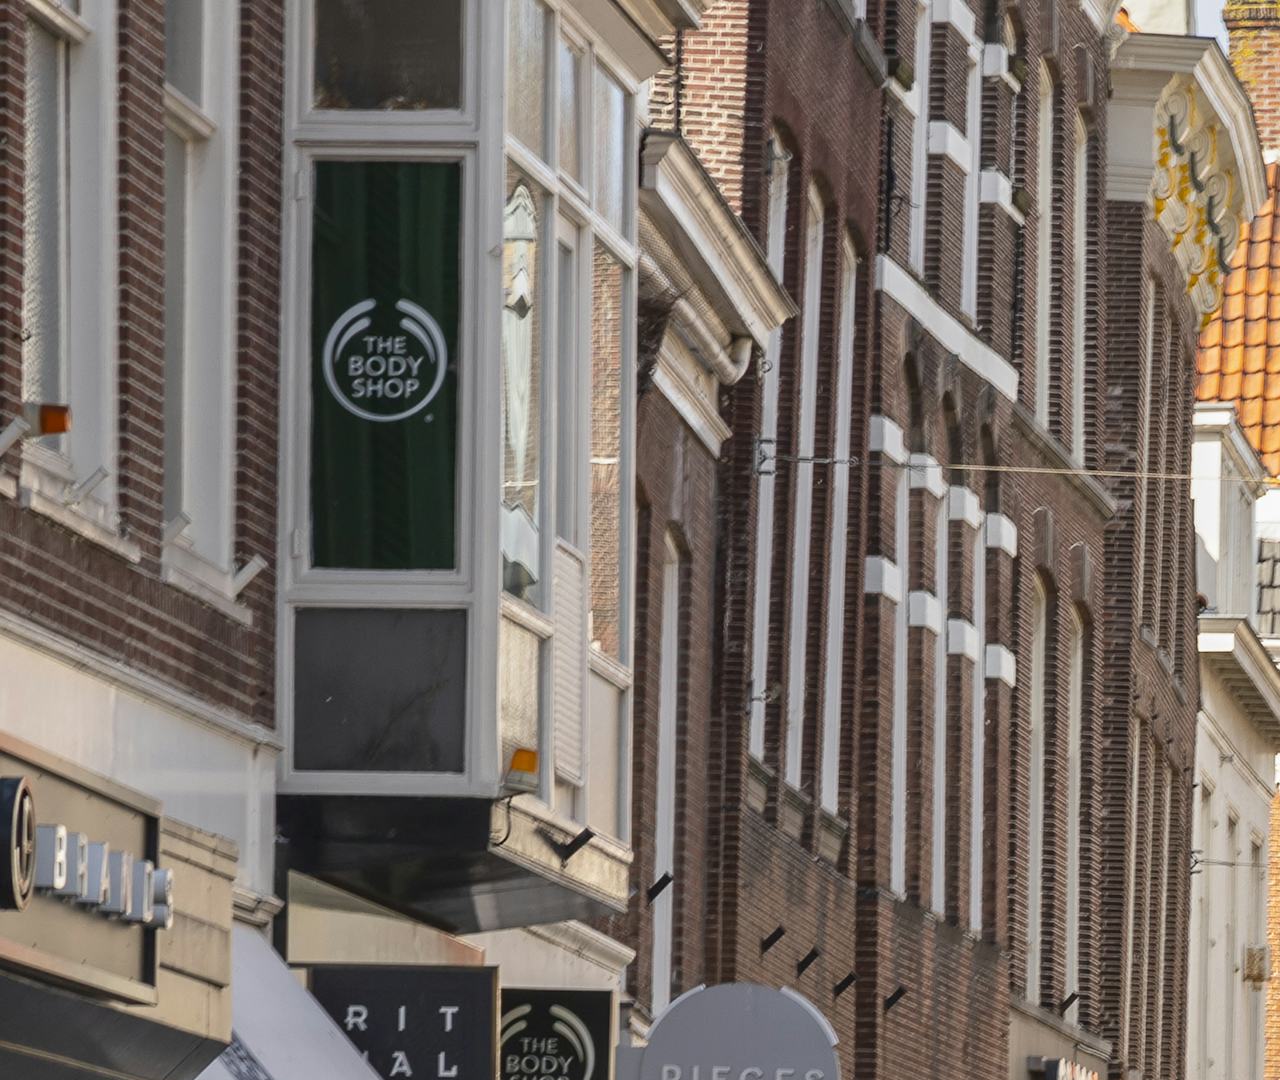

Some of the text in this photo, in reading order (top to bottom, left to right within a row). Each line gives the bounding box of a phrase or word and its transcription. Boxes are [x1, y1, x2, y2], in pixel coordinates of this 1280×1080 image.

[363, 336, 407, 354] THE
[347, 355, 424, 377] BODY
[351, 377, 419, 398] SHOP
[521, 1037, 558, 1054] THE
[362, 1051, 458, 1077] AL
[505, 1055, 573, 1074] BODY
